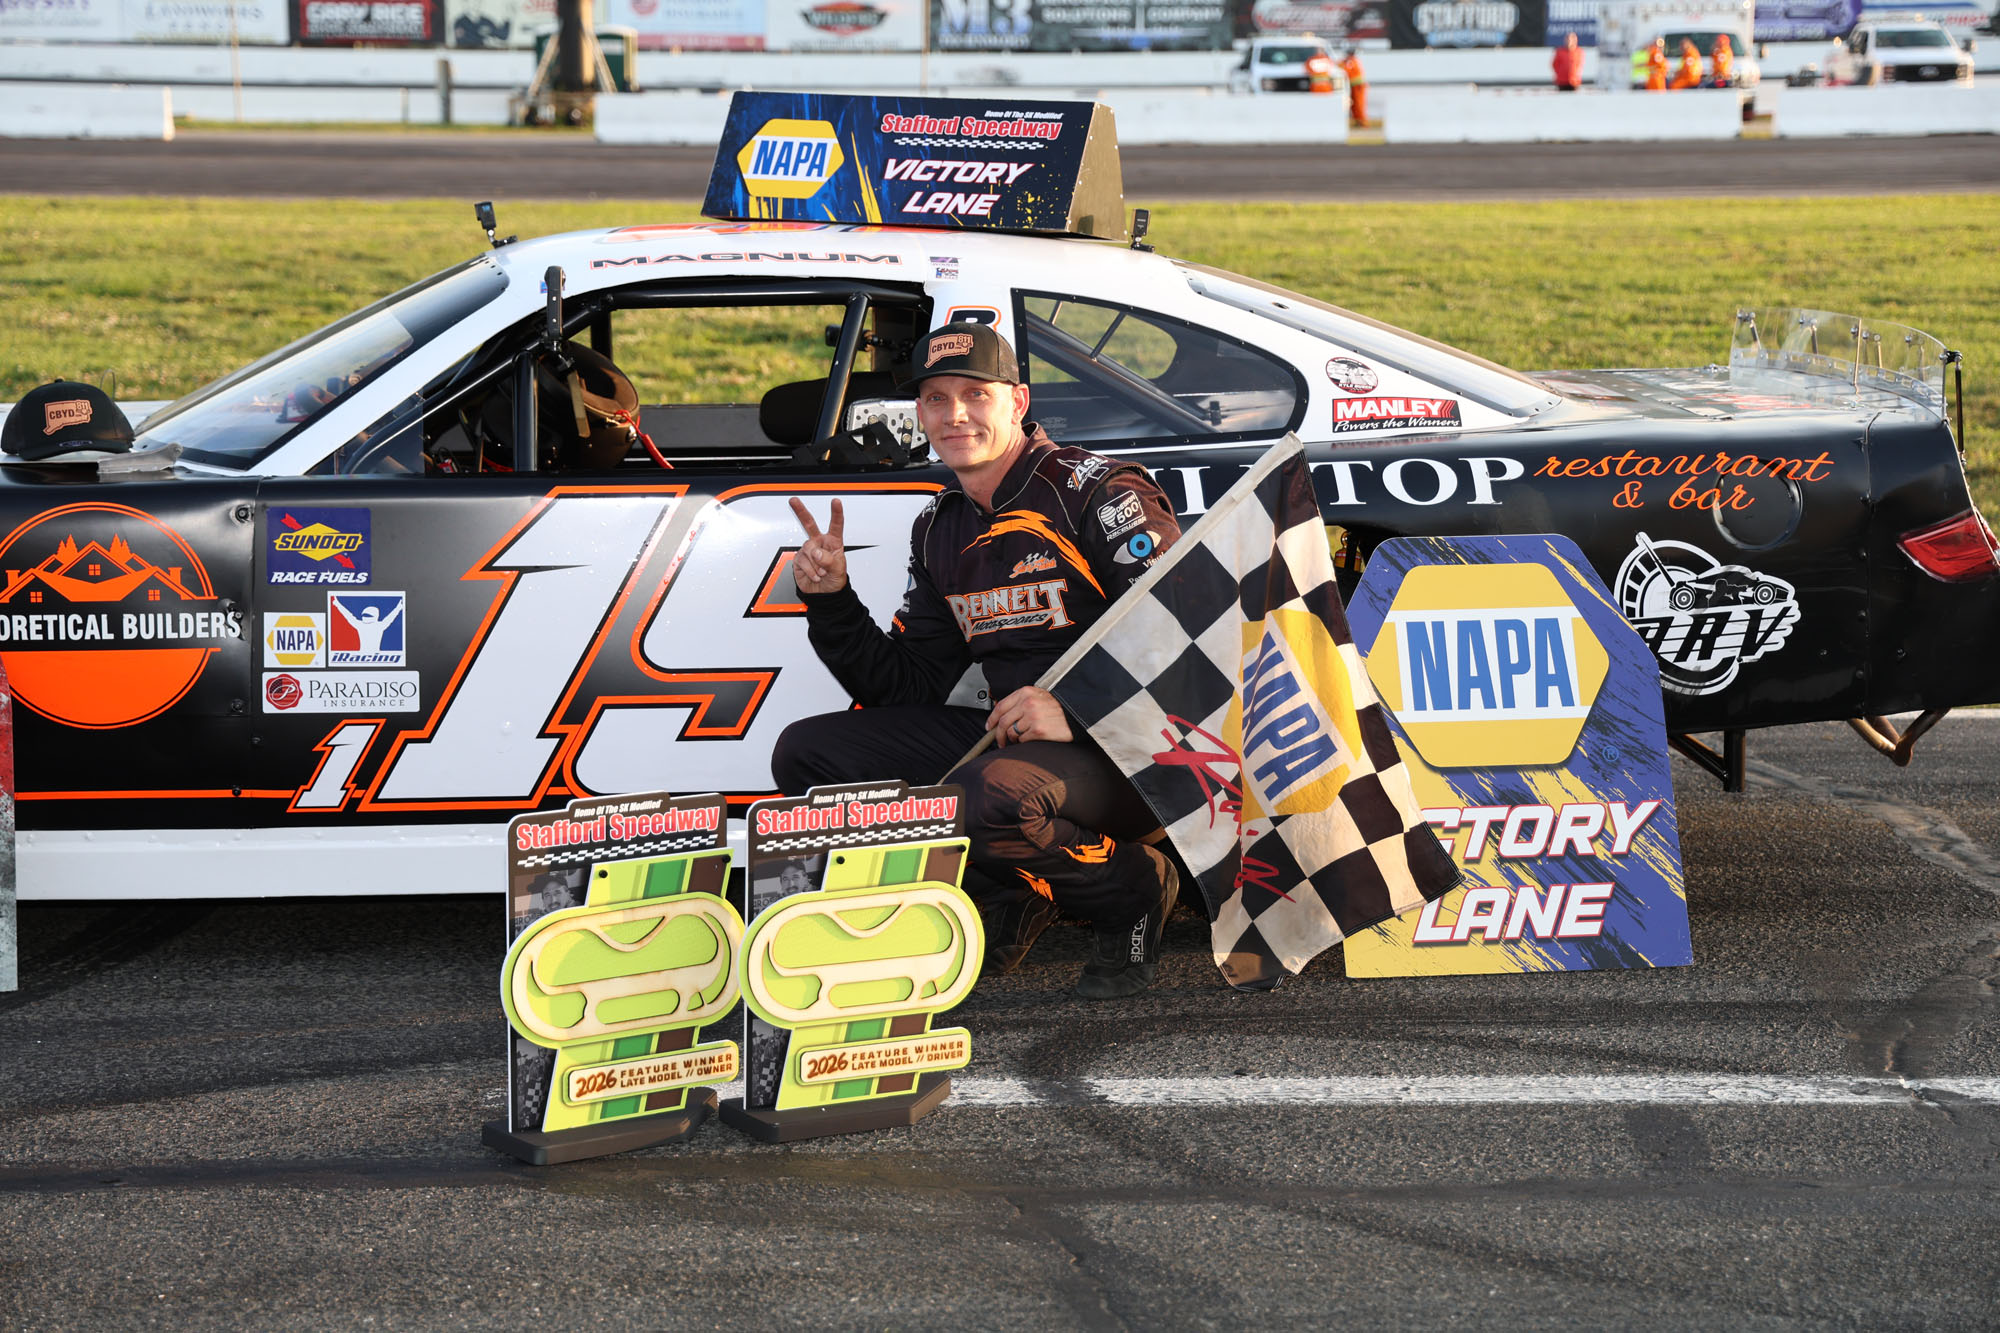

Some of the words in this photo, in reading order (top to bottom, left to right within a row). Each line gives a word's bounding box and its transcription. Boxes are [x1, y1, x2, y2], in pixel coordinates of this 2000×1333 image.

[881, 113, 960, 135] Stafford
[961, 117, 1063, 141] Speedway
[752, 139, 829, 179] NAPA
[884, 158, 1035, 185] VICTORY
[902, 191, 1002, 216] LANE
[590, 252, 902, 269] MAGNUM
[931, 341, 955, 354] CBYD
[49, 408, 75, 420] CBYD
[1336, 399, 1443, 420] MANLEY
[1334, 420, 1380, 432] Powers
[1382, 417, 1406, 428] the
[1408, 416, 1460, 428] Winners
[1533, 449, 1836, 482] restaurant
[1611, 480, 1645, 509] &
[1668, 475, 1756, 511] bar
[1116, 500, 1140, 524] 500
[278, 534, 362, 550] SUNOCO
[271, 571, 317, 583] RACE
[318, 570, 369, 583] FUELS
[945, 580, 1074, 643] BENNETT
[0, 613, 115, 641] ORETICAL
[122, 612, 241, 640] BUILDERS
[276, 629, 315, 651] NAPA
[330, 652, 401, 664] iRacing
[1404, 616, 1577, 712] NAPA
[308, 680, 417, 698] PARADISO
[323, 699, 405, 707] INSURANCE
[1242, 631, 1338, 801] NAPA
[813, 795, 835, 804] Home
[843, 792, 857, 802] The
[857, 791, 868, 801] SK
[867, 788, 901, 800] Modified
[574, 807, 596, 818] Home
[605, 804, 619, 815] The
[619, 803, 630, 813] SK
[629, 800, 662, 812] Modified
[756, 802, 845, 837] Stafford
[847, 795, 959, 829] Speedway
[516, 815, 606, 851] Stafford
[609, 805, 721, 842] Speedway
[1421, 799, 1663, 860] CTORY
[1412, 882, 1616, 943] LANE
[851, 1047, 909, 1062] FEATURE
[914, 1040, 964, 1054] WINNER
[851, 1060, 876, 1071] LATE
[879, 1055, 914, 1068] MODEL
[927, 1049, 964, 1062] DRIVER
[620, 1062, 678, 1079] FEATURE
[683, 1052, 733, 1069] WINNER
[620, 1077, 645, 1089] LATE
[648, 1072, 683, 1085] MODEL
[696, 1063, 733, 1077] OWNER
[806, 1051, 849, 1080] 2026
[575, 1068, 618, 1099] 2026
